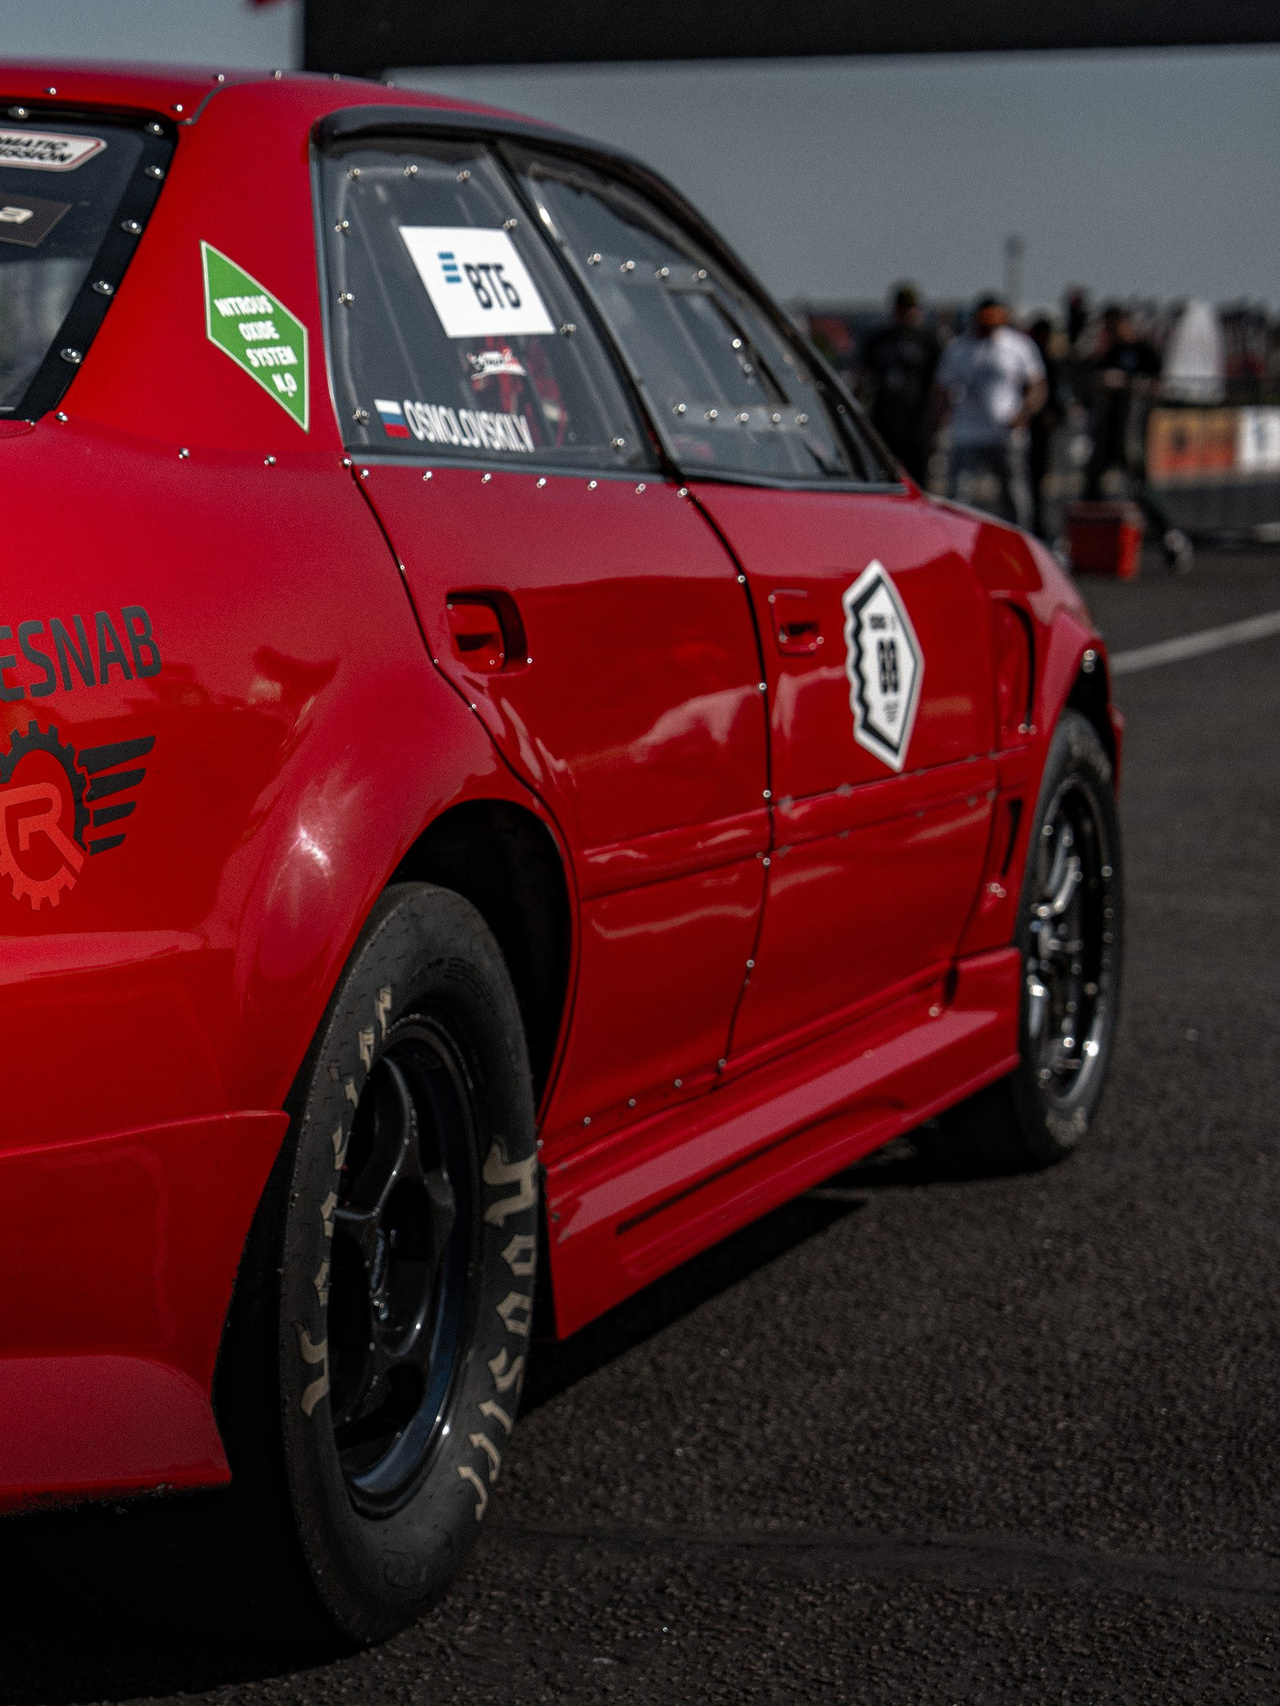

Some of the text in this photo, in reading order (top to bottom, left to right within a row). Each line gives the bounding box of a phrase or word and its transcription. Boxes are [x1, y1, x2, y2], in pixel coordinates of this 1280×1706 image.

[463, 263, 523, 310] ВТБ
[213, 294, 275, 318] NITROUS
[238, 320, 281, 342] OXIDE
[245, 345, 299, 368] SYSTEM
